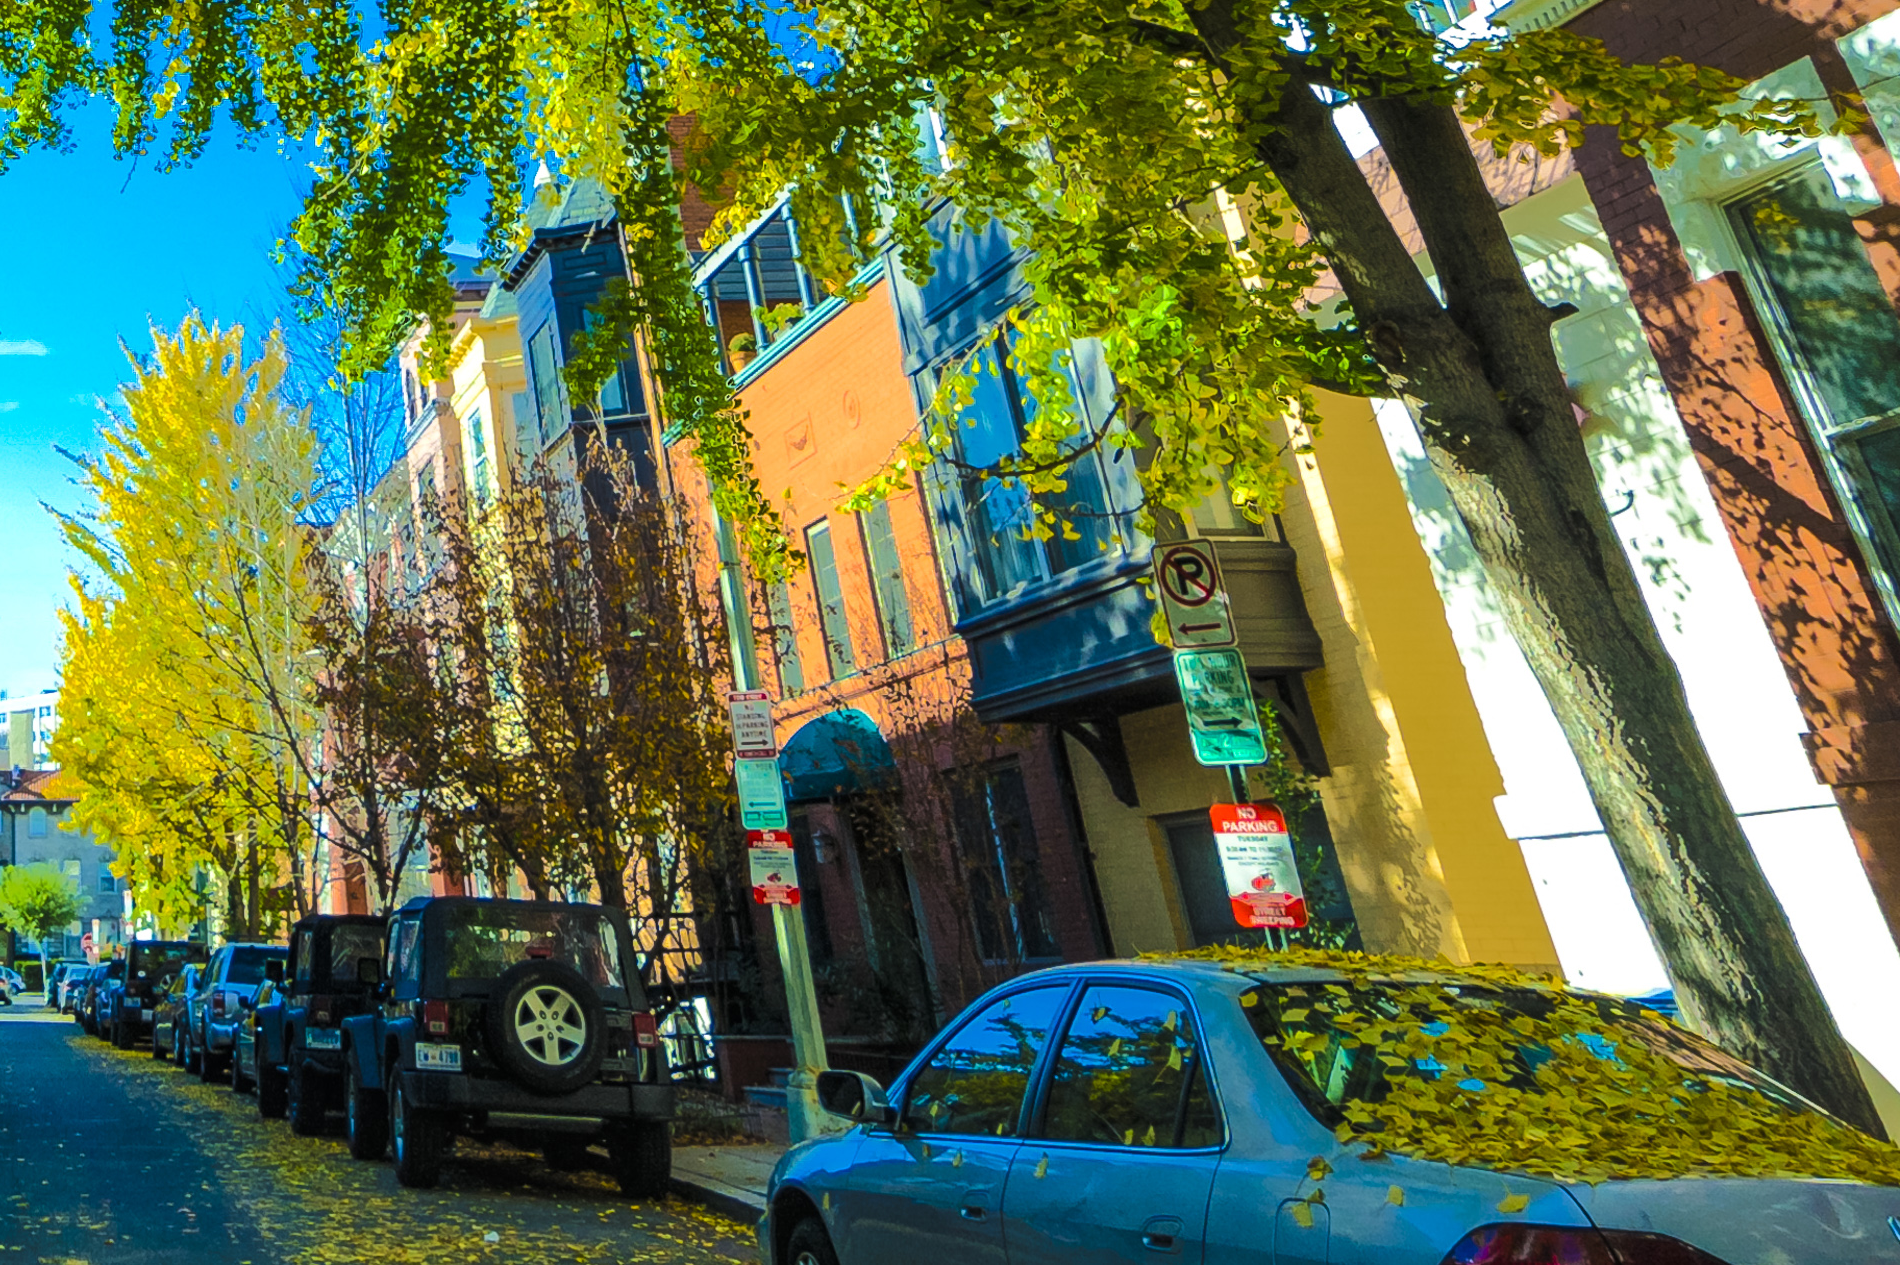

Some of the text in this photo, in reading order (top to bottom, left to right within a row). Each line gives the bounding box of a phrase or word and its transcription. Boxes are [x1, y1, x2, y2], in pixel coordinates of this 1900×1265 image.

[1191, 669, 1235, 685] PRKING
[1236, 807, 1257, 819] NO
[1222, 820, 1278, 832] PARKING
